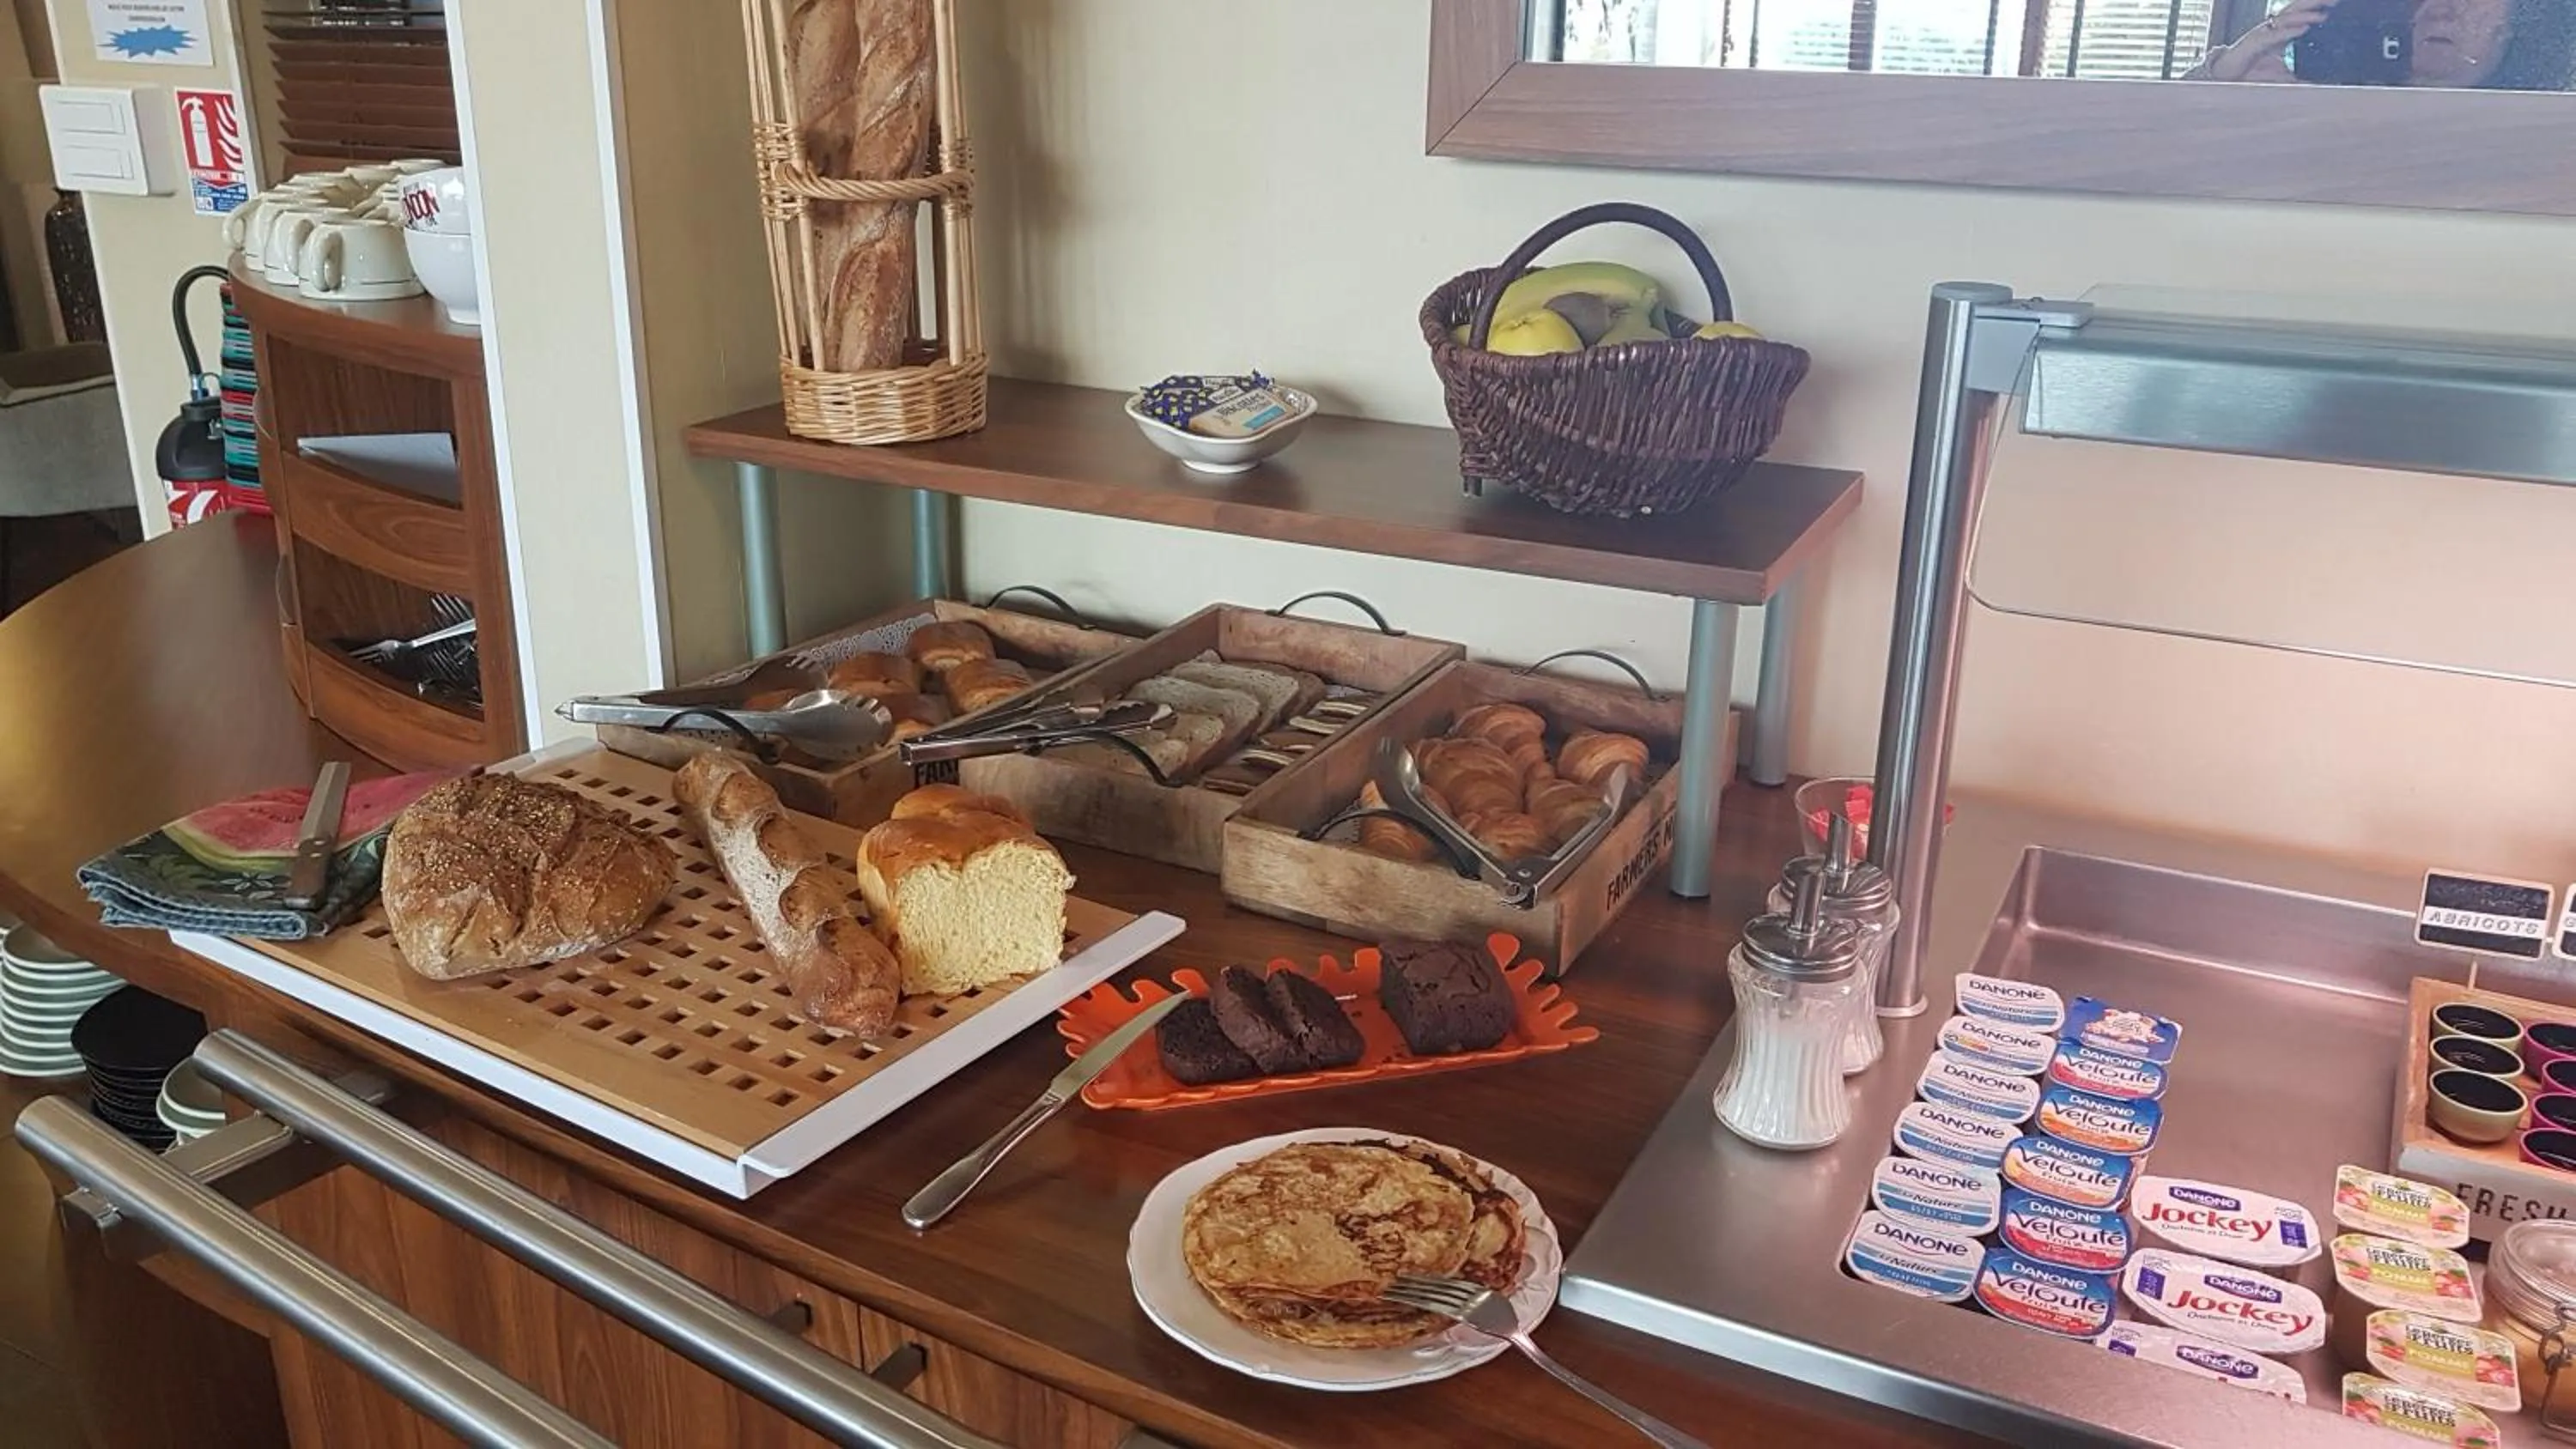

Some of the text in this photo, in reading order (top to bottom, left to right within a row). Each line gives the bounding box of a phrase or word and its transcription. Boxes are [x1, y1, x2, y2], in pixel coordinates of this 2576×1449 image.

[1607, 831, 1661, 911] FARMERS
[2429, 911, 2539, 934] ABRICOTS
[2142, 1203, 2273, 1242] Jockey
[2167, 1290, 2313, 1336] Jockey
